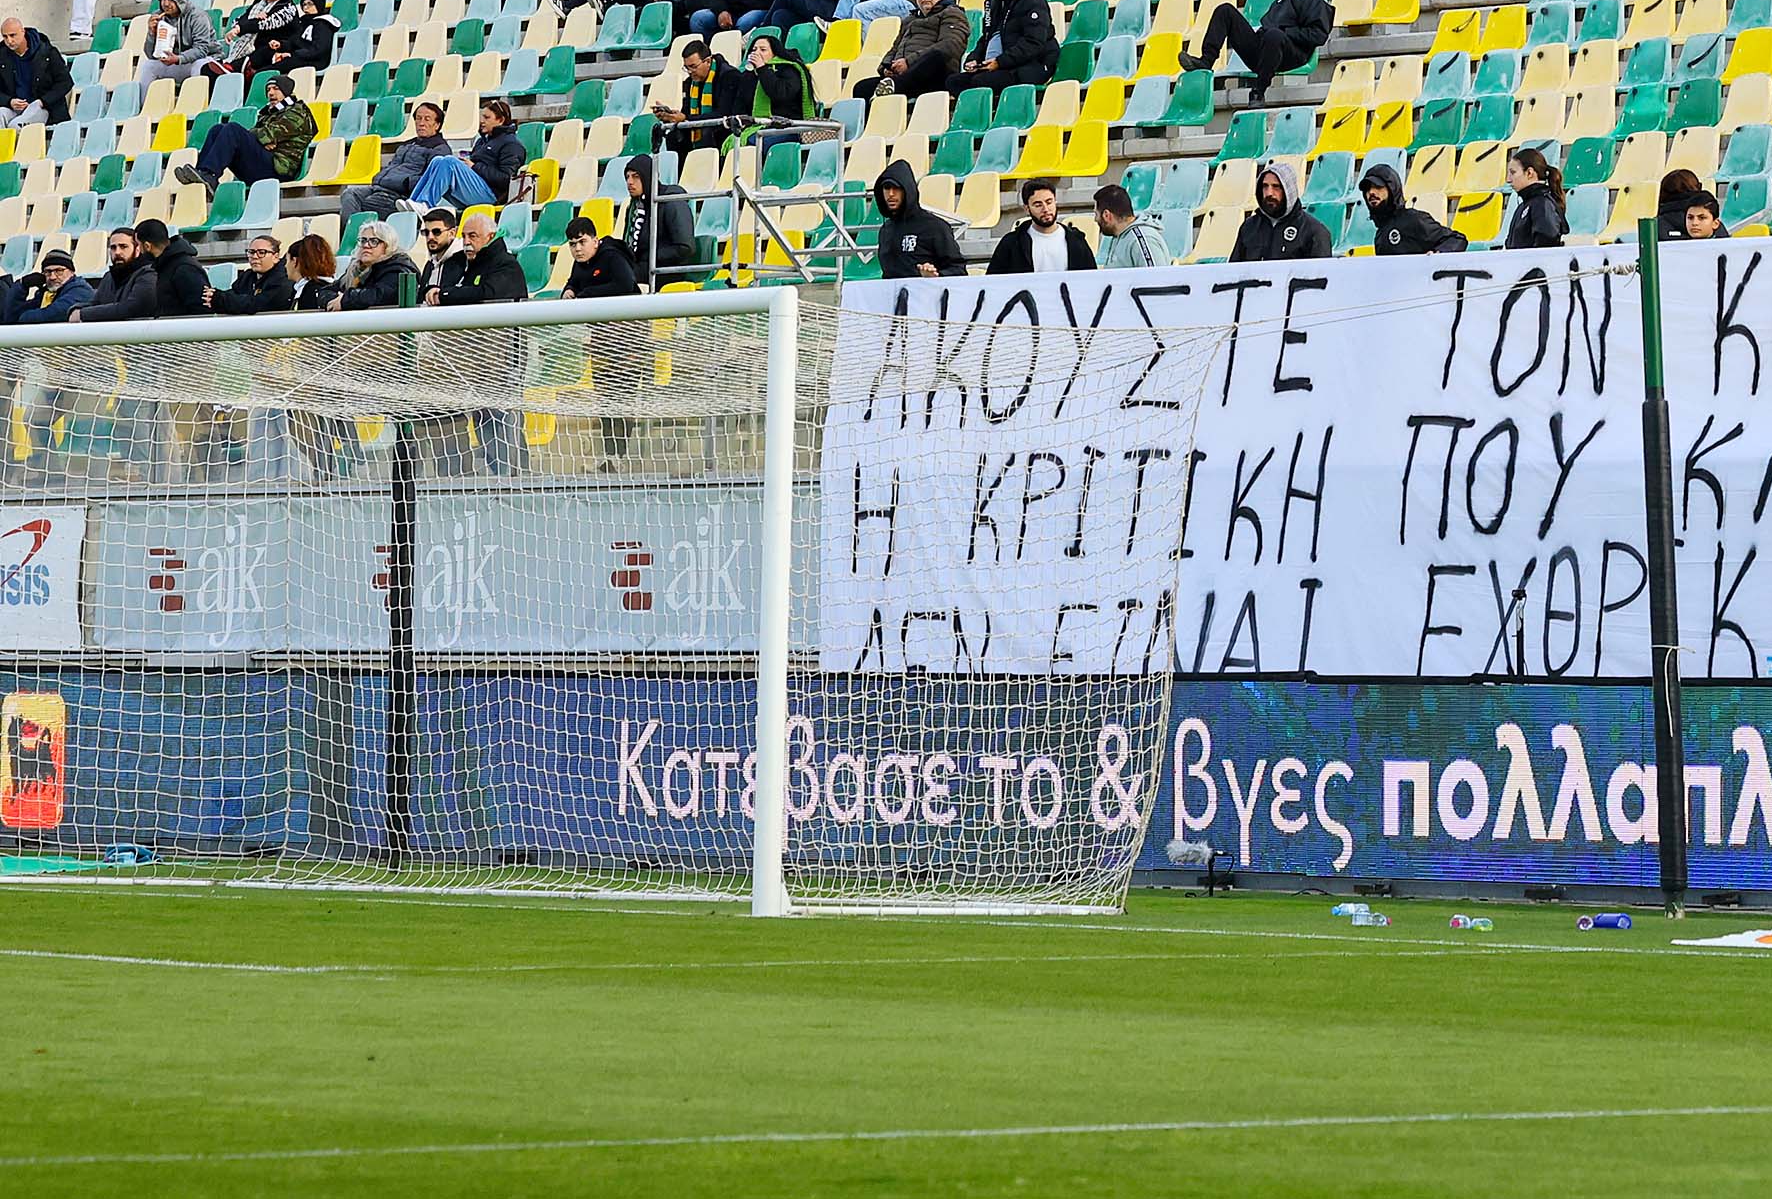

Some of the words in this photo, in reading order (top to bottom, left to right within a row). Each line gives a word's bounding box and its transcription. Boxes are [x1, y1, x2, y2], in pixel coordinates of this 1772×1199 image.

[301, 25, 313, 42] A
[1432, 257, 1613, 397] ΤΟΝ
[1400, 413, 1604, 546] ΠΟΥ
[979, 756, 1062, 830] το
[1091, 723, 1144, 833] &
[1174, 718, 1353, 870] βγες
